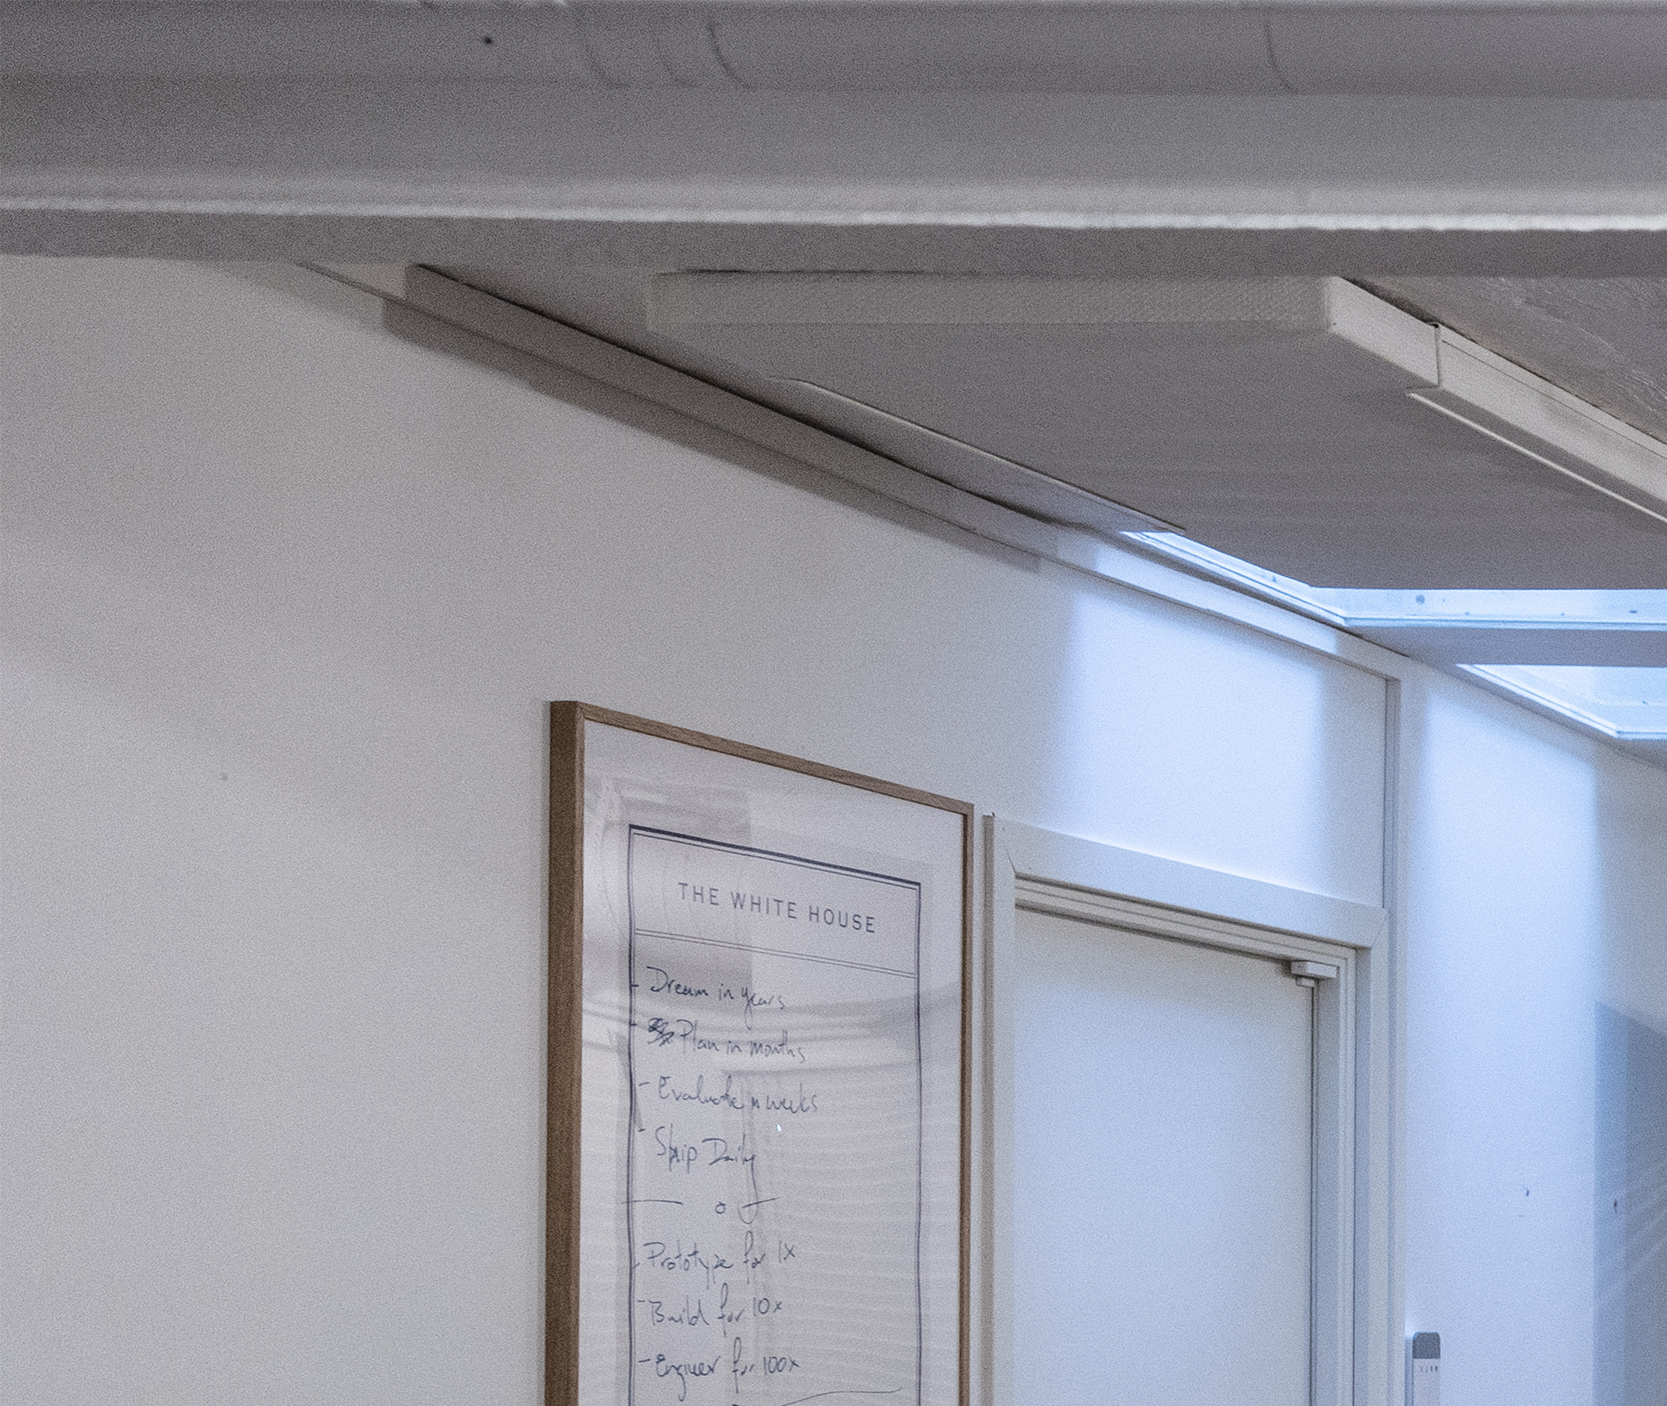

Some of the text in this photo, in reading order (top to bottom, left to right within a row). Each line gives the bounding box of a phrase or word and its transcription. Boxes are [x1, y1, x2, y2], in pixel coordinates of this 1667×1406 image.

[678, 882, 876, 934] THE WHITE HOUSE
[646, 966, 785, 1031] Dream in years
[676, 1018, 720, 1054] Plan
[726, 1039, 743, 1055] in
